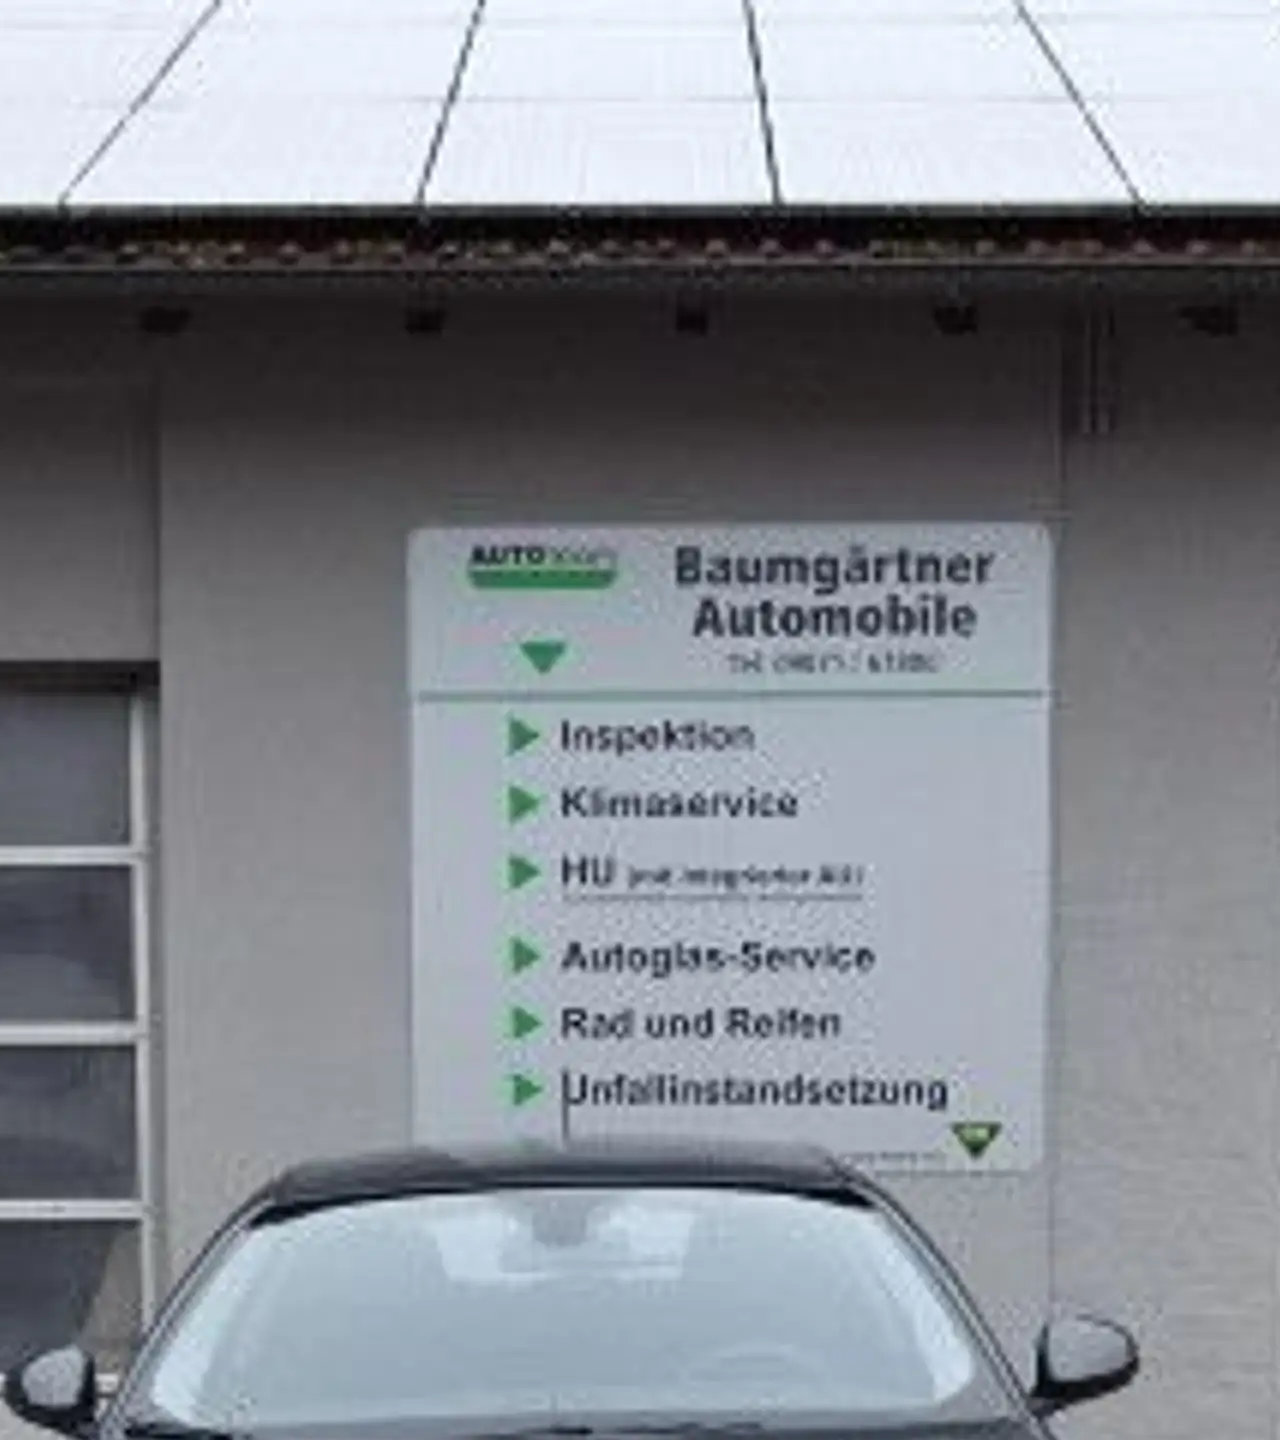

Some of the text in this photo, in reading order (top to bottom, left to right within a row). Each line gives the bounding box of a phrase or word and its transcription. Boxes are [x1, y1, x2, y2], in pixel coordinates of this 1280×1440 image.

[675, 545, 996, 596] Baumgärtner
[692, 593, 978, 638] Automobile
[561, 719, 756, 757] Inspektion
[561, 786, 798, 818] Klimaservice
[561, 853, 616, 887] HU
[561, 941, 877, 978] Autoglas-Service
[561, 1007, 842, 1039] Rad und Reifen
[561, 1071, 950, 1111] Unfallinstandsetzung
